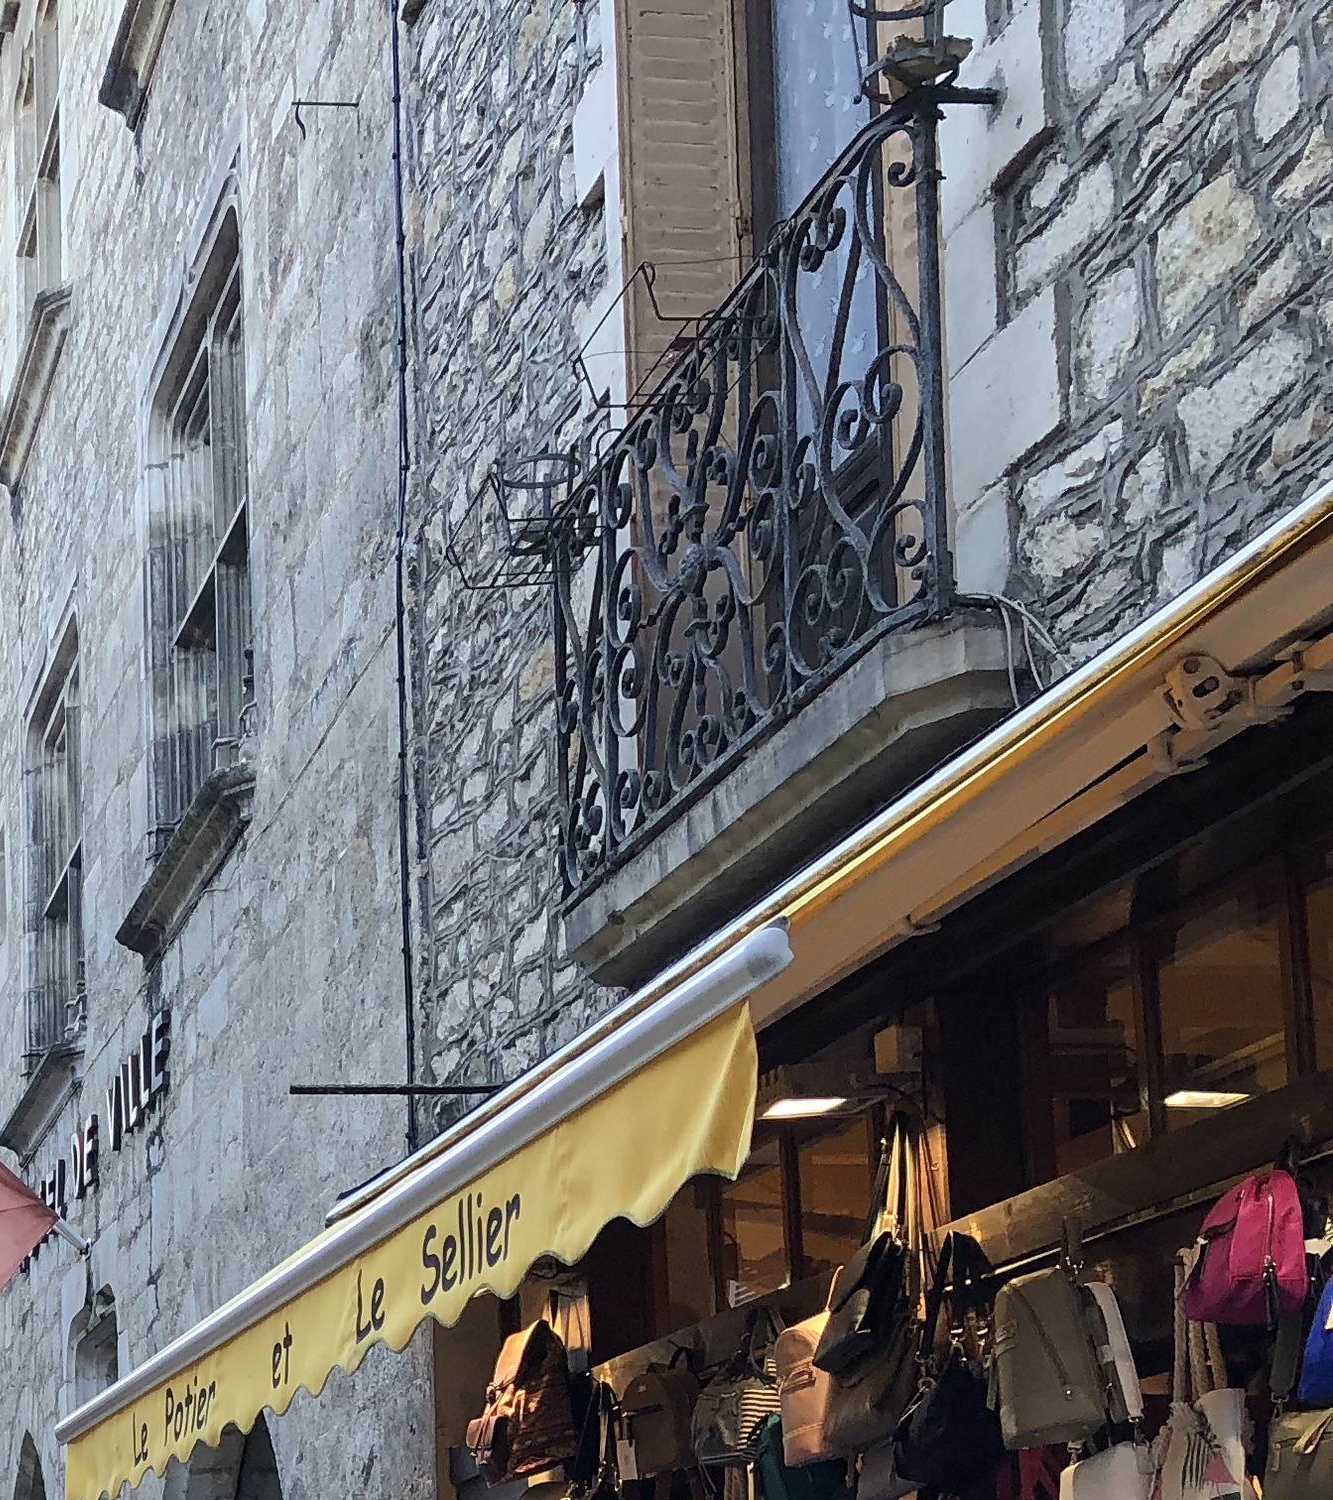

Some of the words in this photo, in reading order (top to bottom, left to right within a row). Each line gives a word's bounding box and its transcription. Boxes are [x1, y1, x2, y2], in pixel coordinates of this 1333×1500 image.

[71, 1114, 98, 1200] DE
[106, 1009, 171, 1152] VILLE
[132, 1411, 150, 1468] Le
[164, 1377, 217, 1444] Potier
[271, 1321, 293, 1390] et
[355, 1261, 386, 1345] Le
[420, 1191, 522, 1307] Sellier
